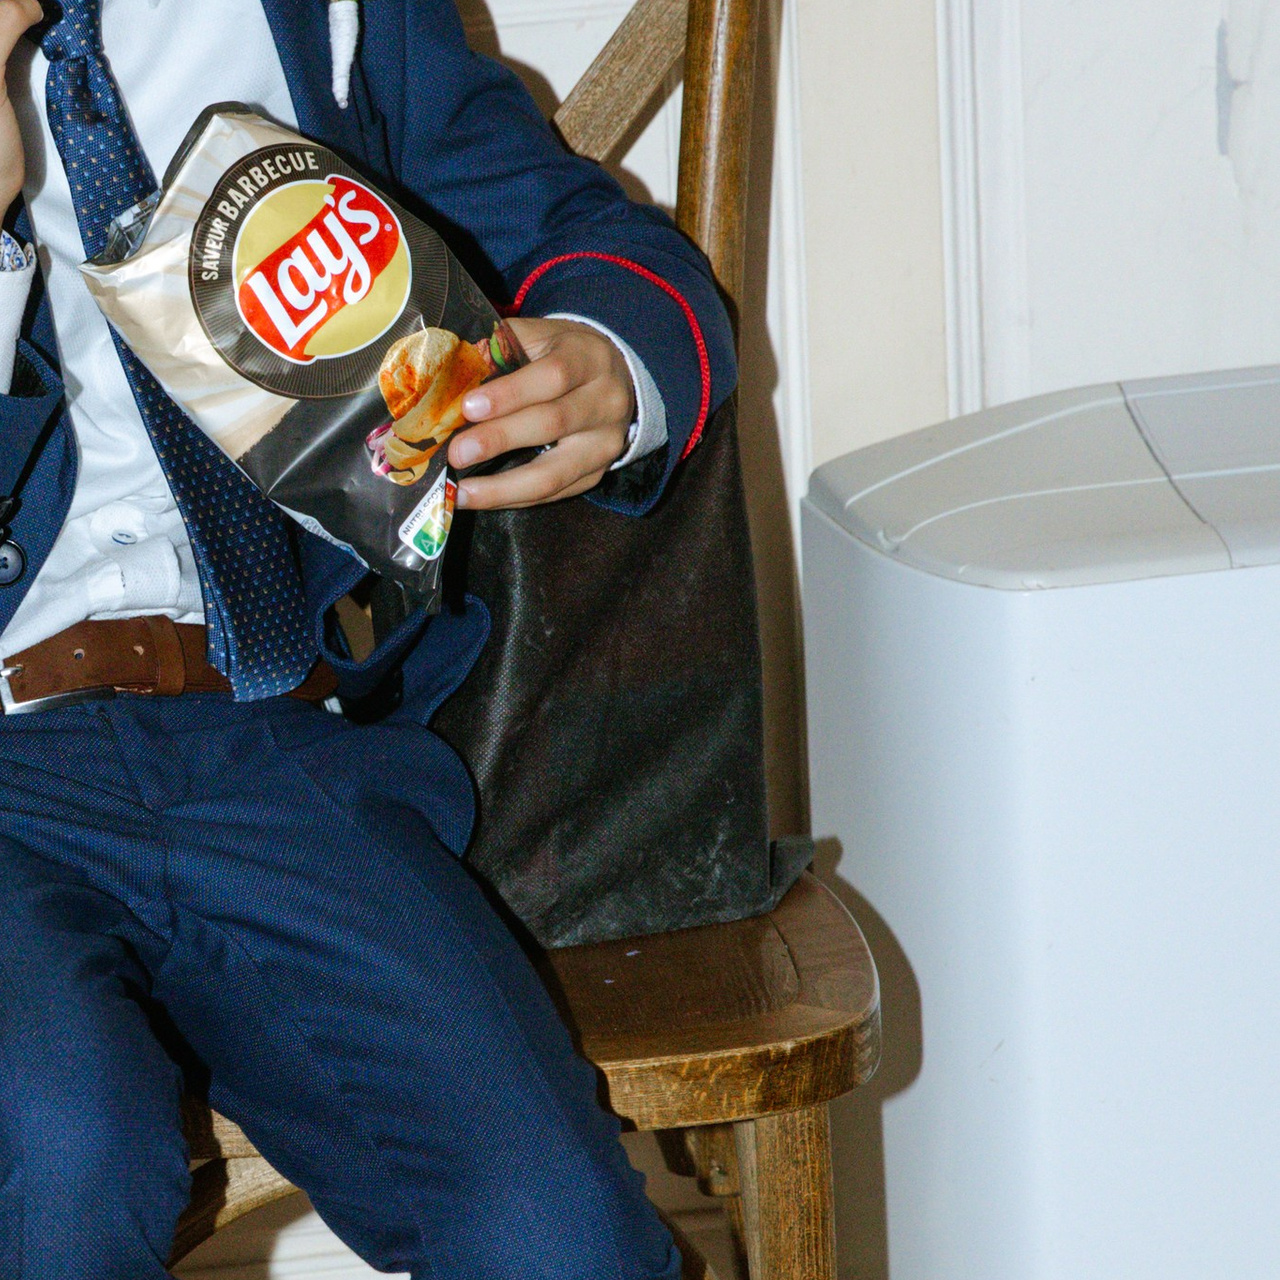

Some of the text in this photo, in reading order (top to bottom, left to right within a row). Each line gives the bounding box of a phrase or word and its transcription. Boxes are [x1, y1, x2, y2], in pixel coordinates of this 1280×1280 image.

[201, 151, 319, 281] SAVEUR BARBECUE
[246, 189, 380, 351] Lay's
[402, 482, 446, 536] NUTRI-SCORE
